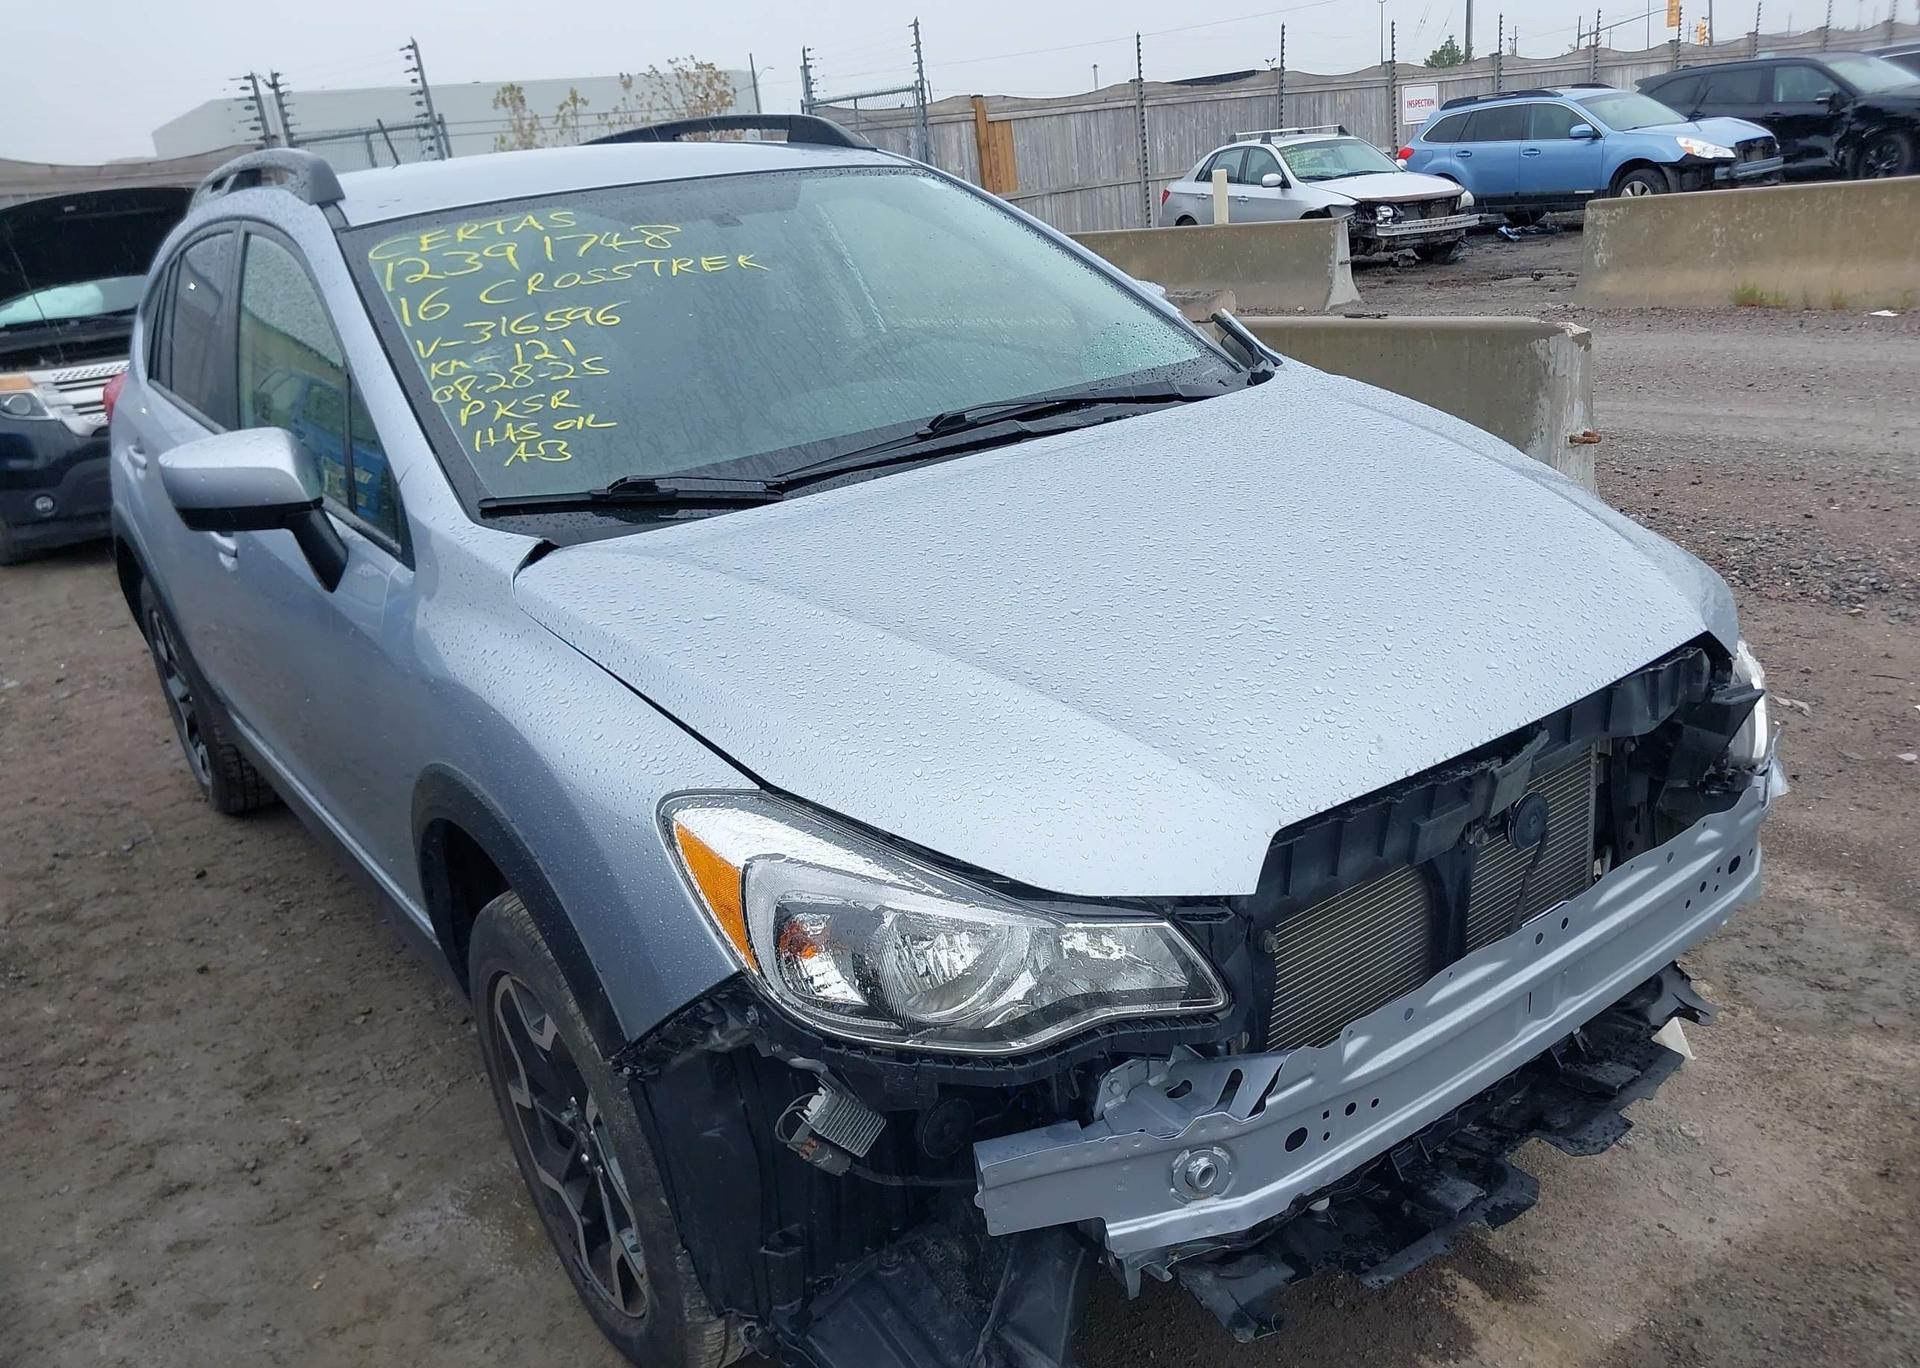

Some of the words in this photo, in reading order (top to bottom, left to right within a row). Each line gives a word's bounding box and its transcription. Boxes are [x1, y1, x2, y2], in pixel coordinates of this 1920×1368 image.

[1406, 98, 1435, 109] INSPECTION
[368, 212, 577, 260] CERTAS
[400, 286, 451, 327] 16
[479, 253, 772, 304] CROSSTREK
[474, 422, 543, 453] HAS
[504, 438, 573, 467] AB
